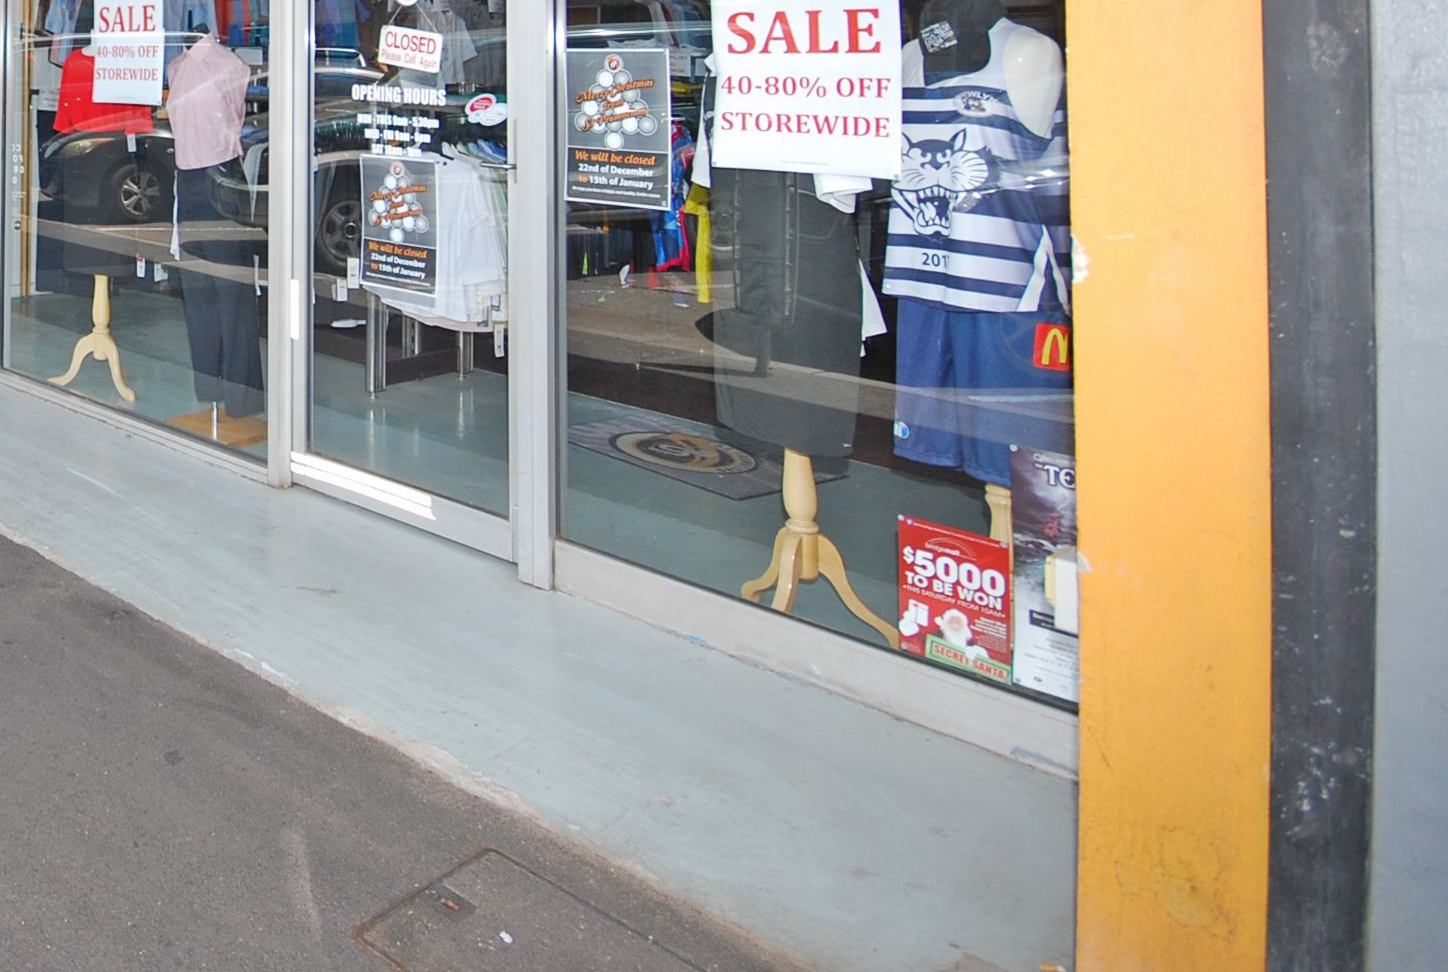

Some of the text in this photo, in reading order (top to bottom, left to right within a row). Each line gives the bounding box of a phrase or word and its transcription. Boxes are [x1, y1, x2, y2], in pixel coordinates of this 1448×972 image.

[99, 3, 158, 34] SALE
[726, 7, 883, 56] SALE
[96, 44, 160, 59] 40-80% OFF
[384, 30, 437, 56] CLOSED
[404, 52, 418, 66] Call
[419, 56, 439, 70] Again
[96, 67, 159, 82] STOREWIDE
[351, 83, 402, 104] OPENING
[403, 87, 447, 107] HOURS
[607, 78, 656, 98] Christmas
[720, 74, 893, 100] 40-80% OFF
[720, 110, 892, 140] STOREWIDE
[575, 149, 656, 166] We will be closed
[578, 162, 654, 177] 22nd of December
[578, 174, 653, 191] to 15th of January
[368, 241, 427, 258] We will be closed
[370, 252, 425, 268] 22nd of December
[922, 251, 951, 269] 201
[378, 263, 391, 272] 15th
[392, 265, 399, 273] of
[399, 267, 425, 279] January
[902, 545, 1006, 598] $5000
[905, 571, 1003, 611] TO BE WON
[957, 599, 980, 613] FROM
[934, 643, 1006, 679] SECRET SANTA
